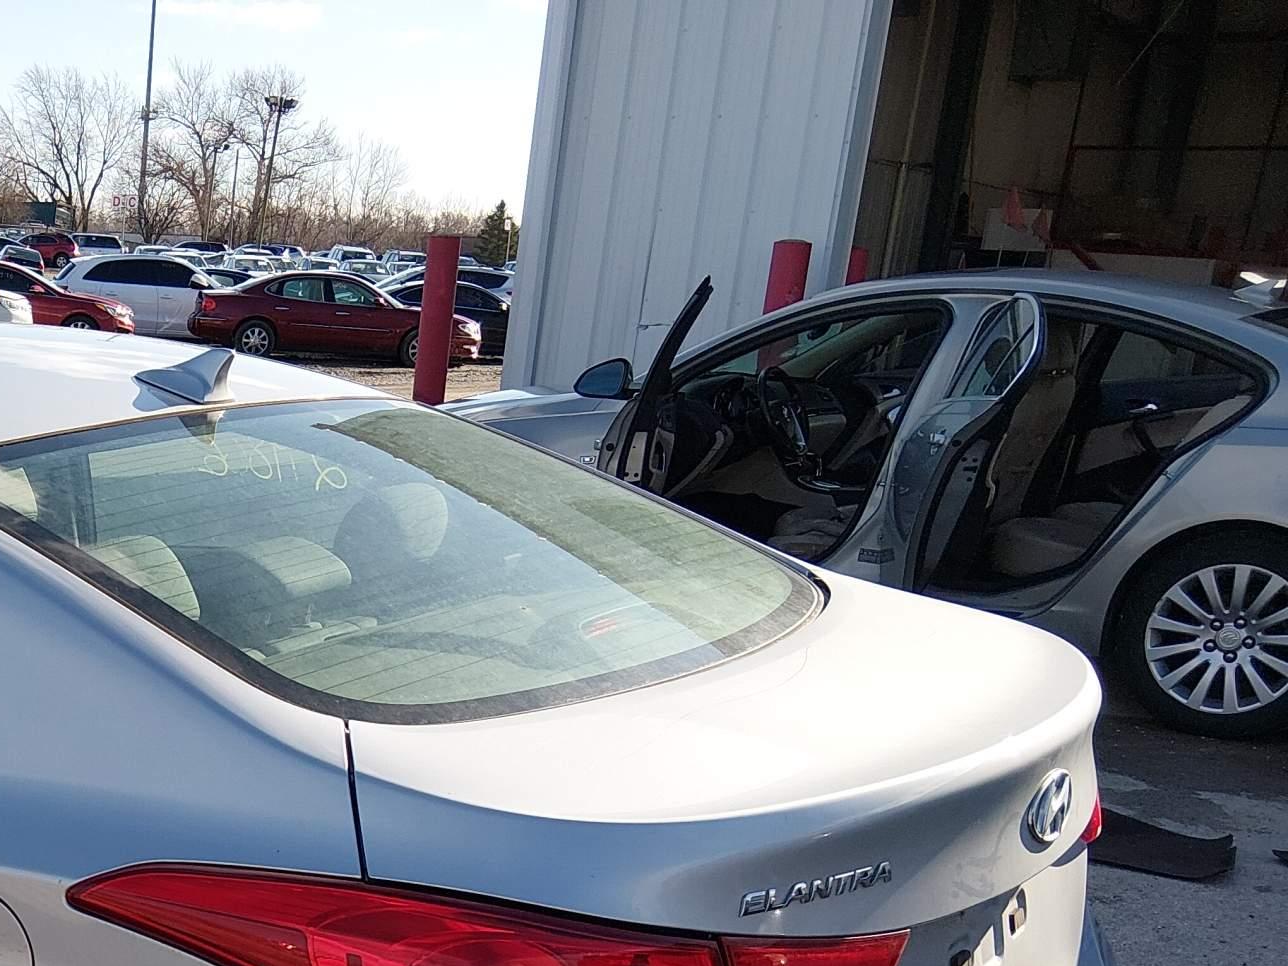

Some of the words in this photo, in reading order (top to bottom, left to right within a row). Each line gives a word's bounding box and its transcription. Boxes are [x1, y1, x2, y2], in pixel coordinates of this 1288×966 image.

[113, 196, 121, 207] D
[128, 196, 136, 207] C
[738, 860, 893, 918] ELANTRA
